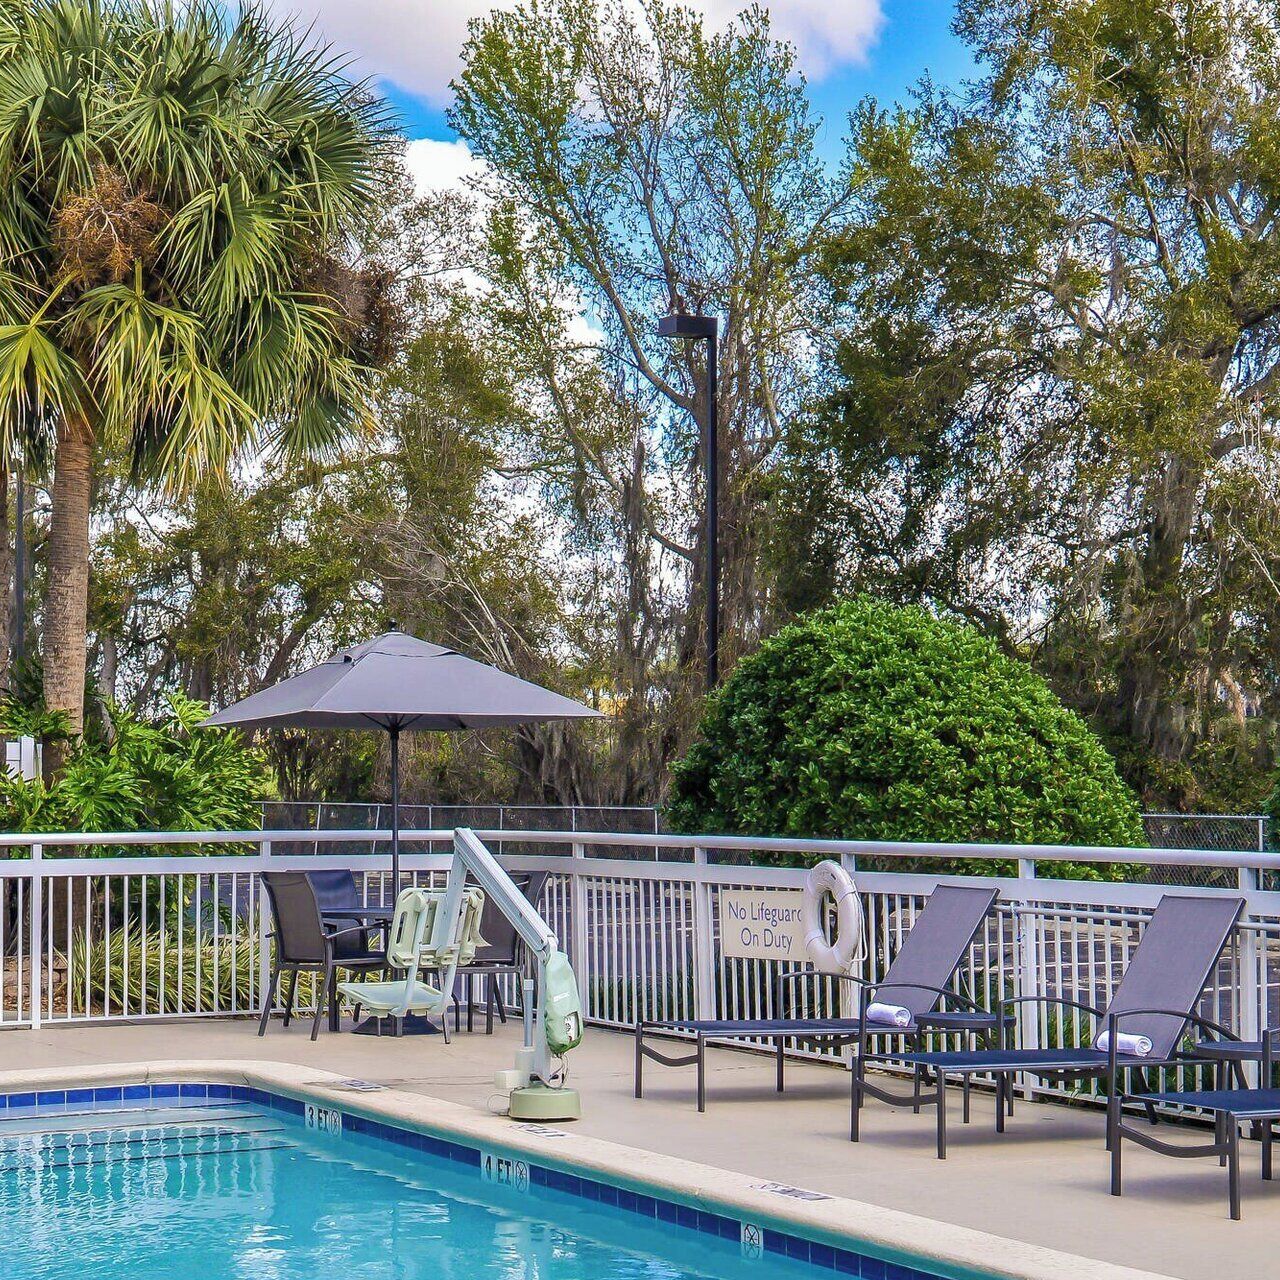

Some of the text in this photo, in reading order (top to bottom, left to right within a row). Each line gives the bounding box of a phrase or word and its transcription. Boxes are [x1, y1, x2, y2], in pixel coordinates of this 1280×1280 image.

[728, 901, 747, 920] No
[740, 927, 793, 954] On Duty
